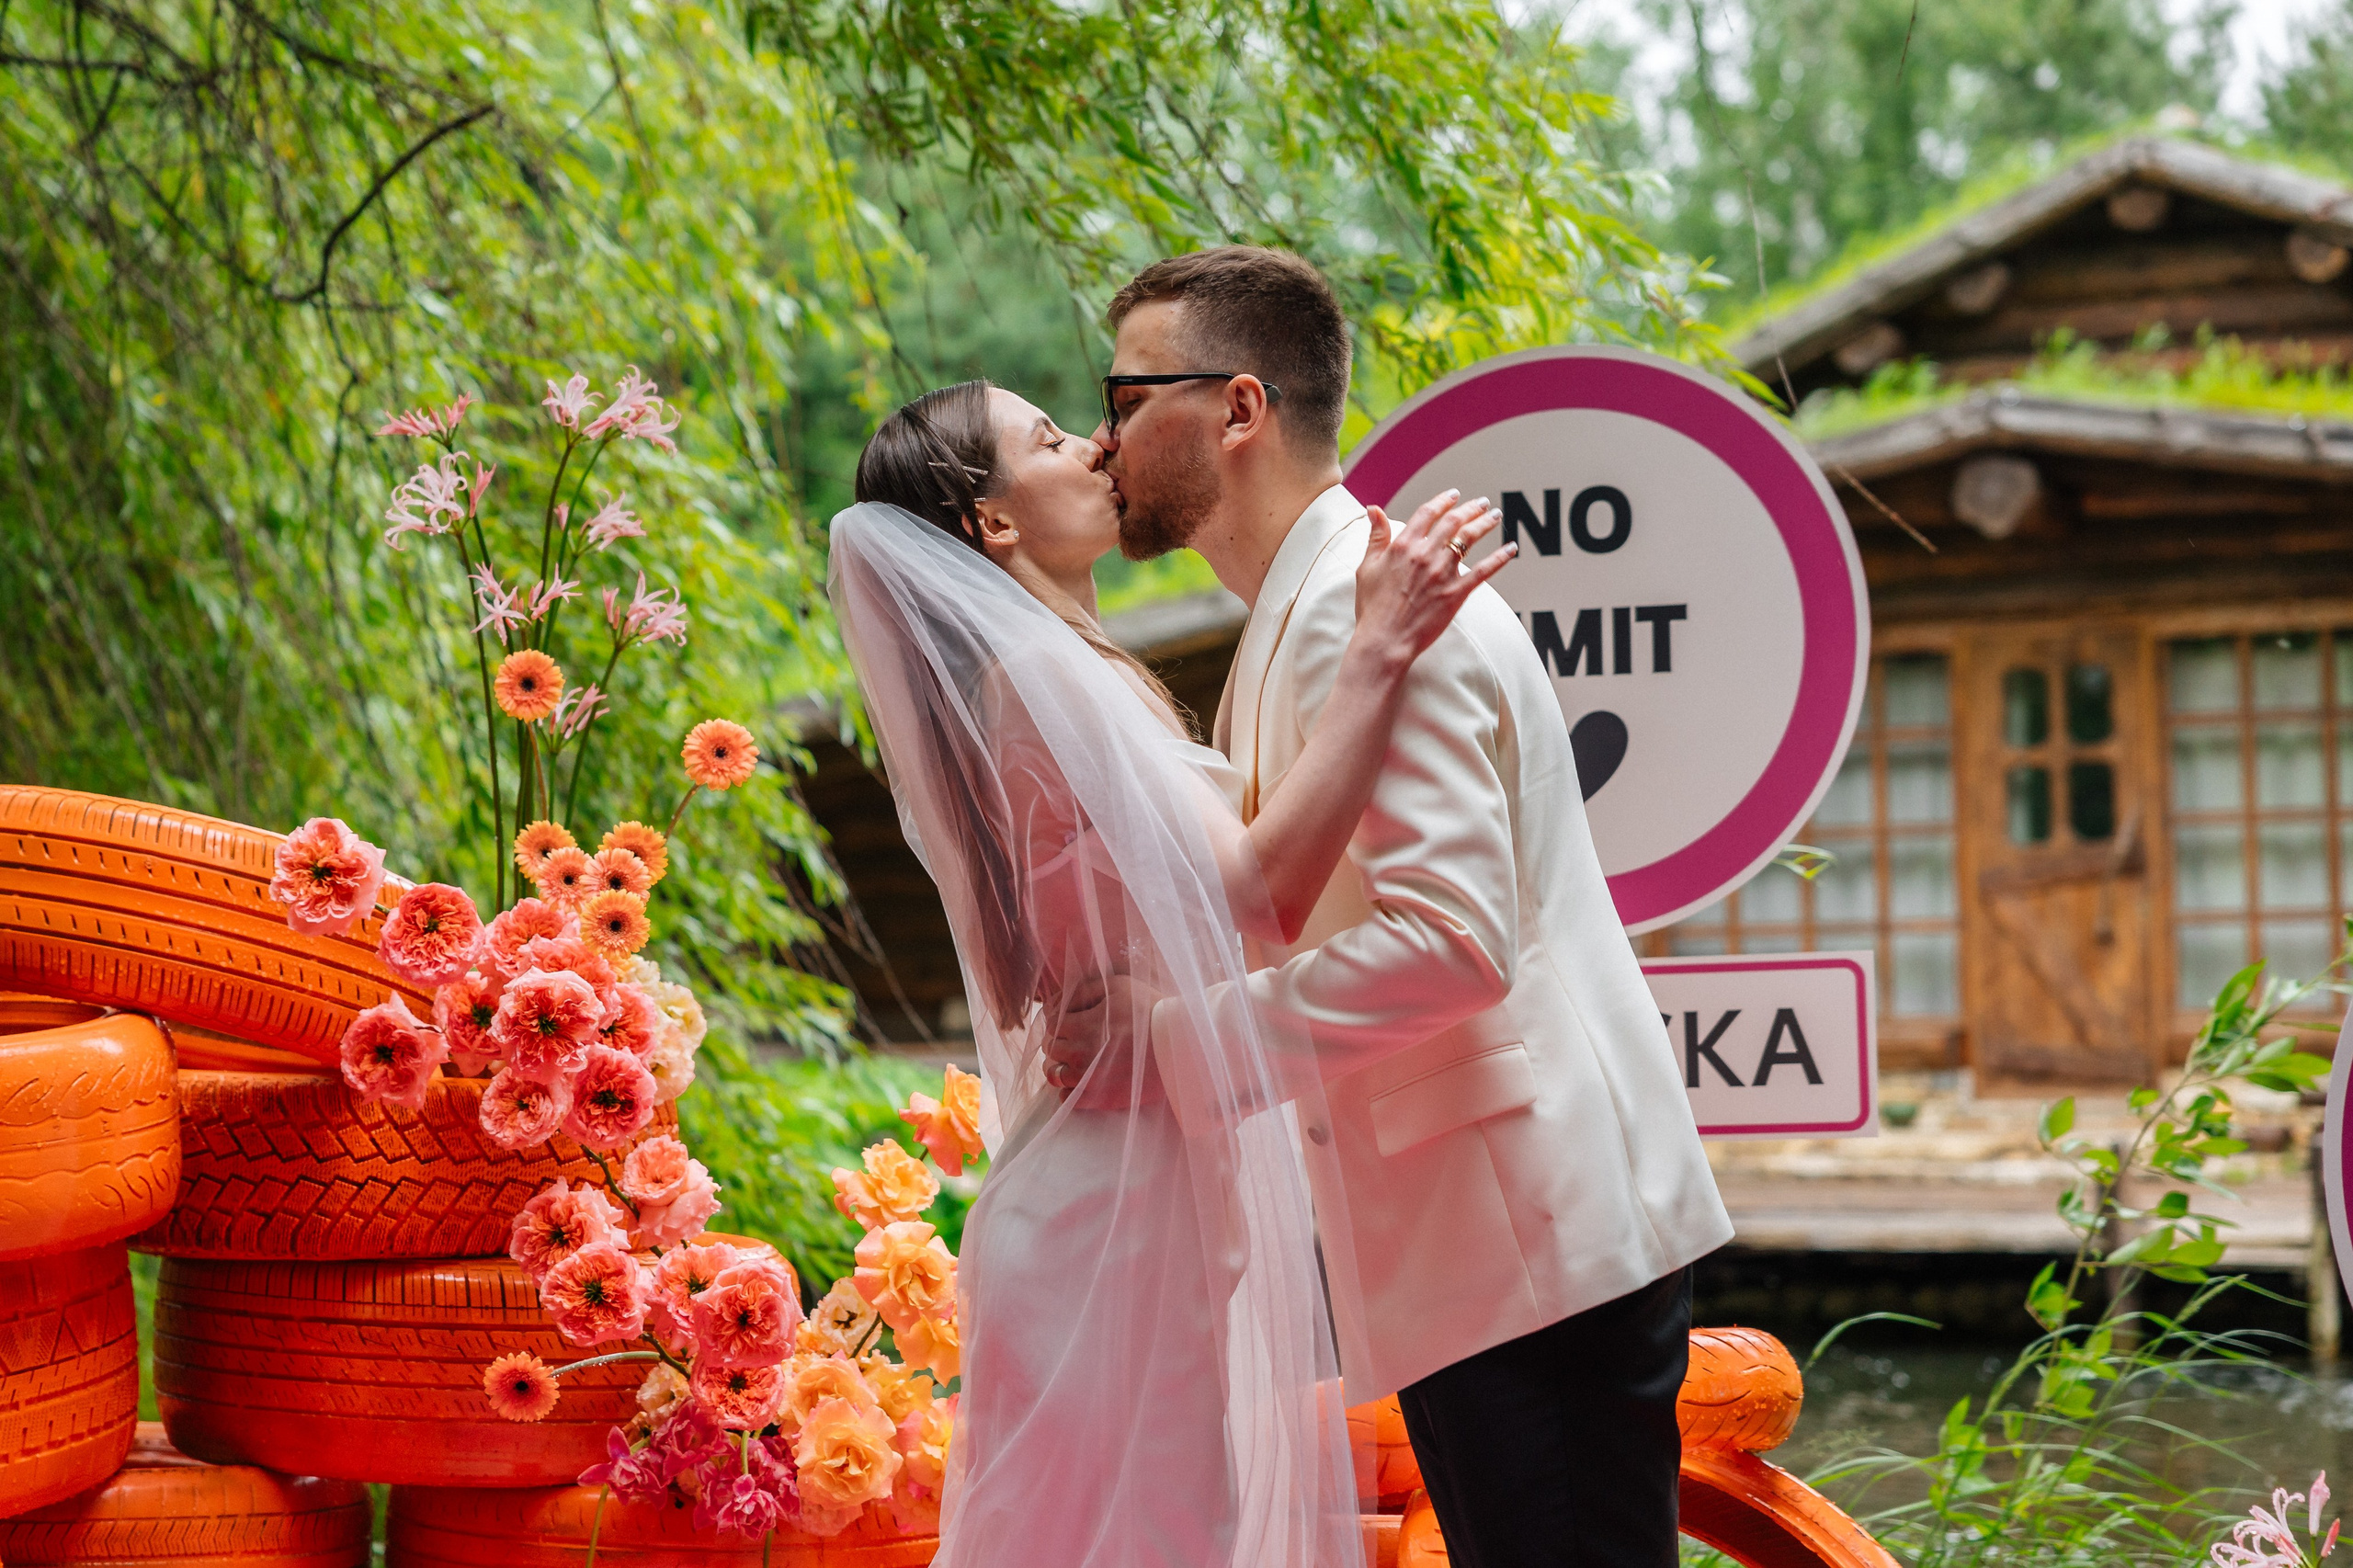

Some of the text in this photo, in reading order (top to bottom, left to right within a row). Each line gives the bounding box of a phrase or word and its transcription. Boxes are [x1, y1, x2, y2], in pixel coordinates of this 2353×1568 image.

[1501, 485, 1632, 558] NO
[1514, 604, 1688, 677] MIT
[1660, 1007, 1824, 1088] KA
